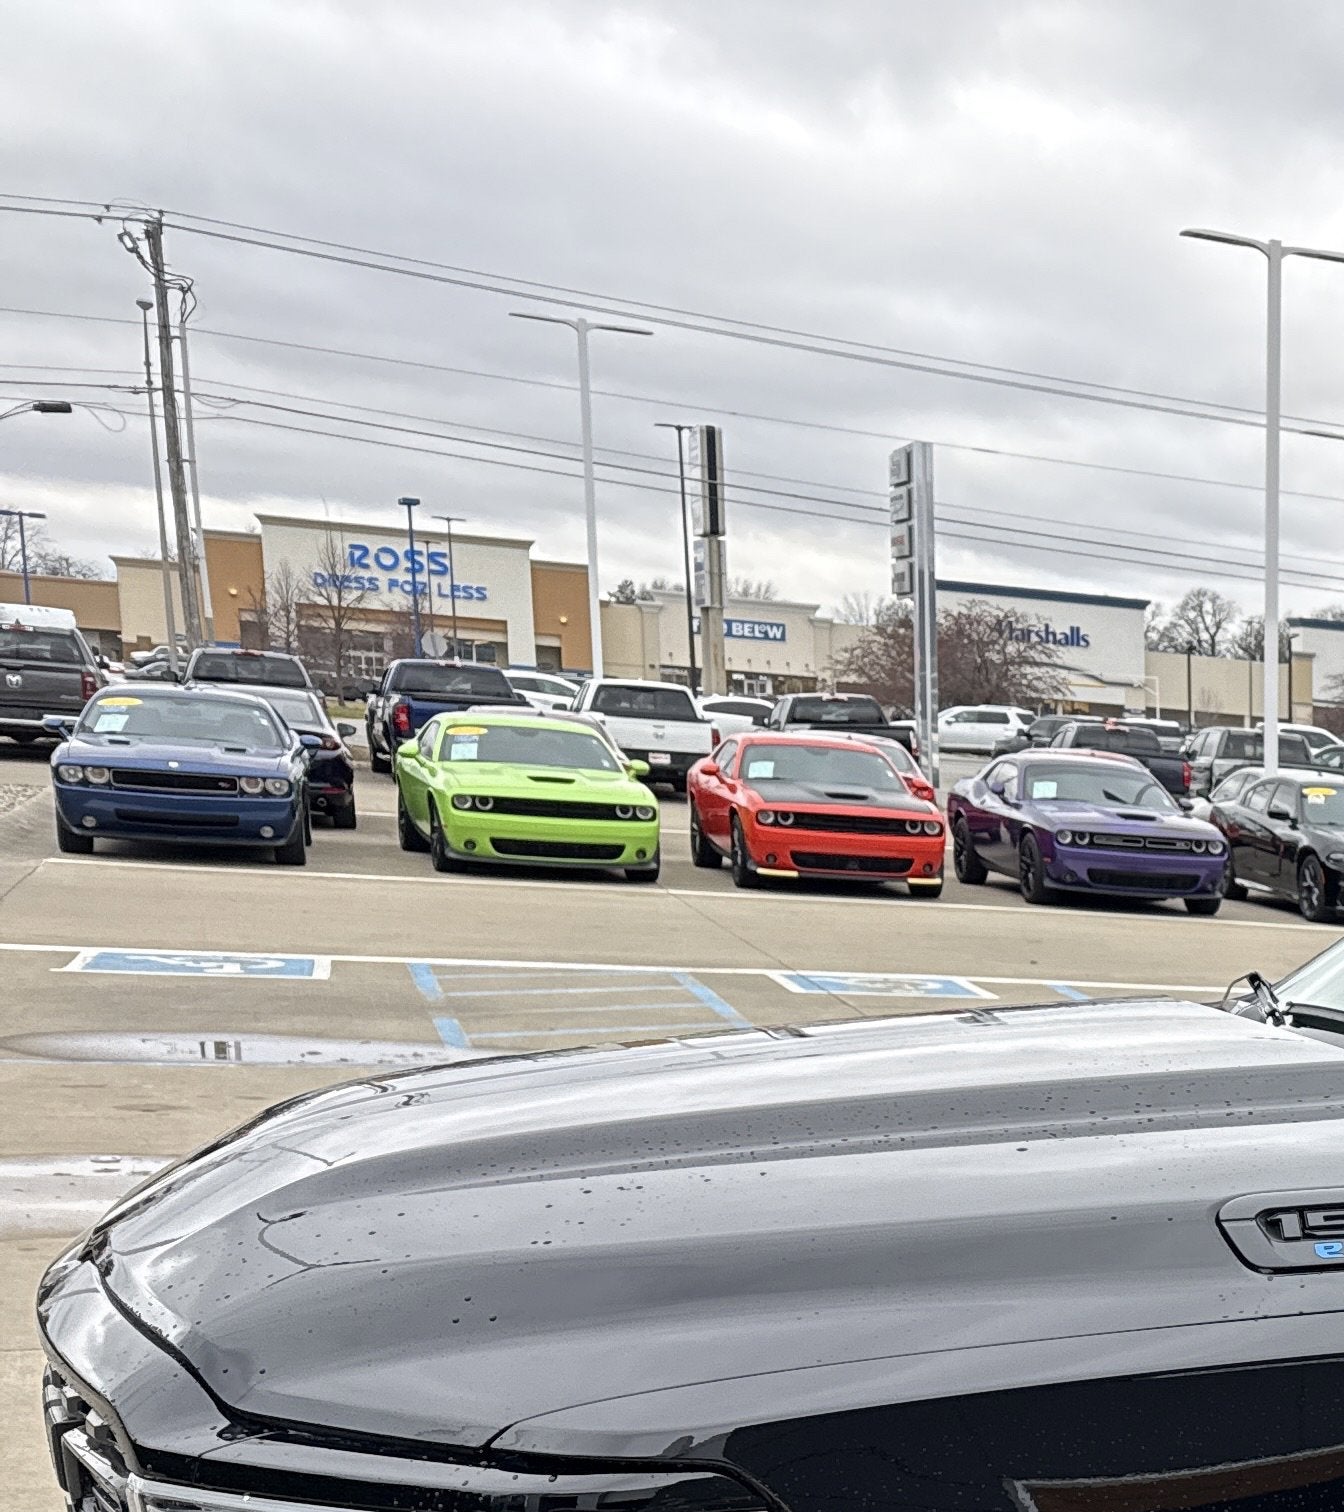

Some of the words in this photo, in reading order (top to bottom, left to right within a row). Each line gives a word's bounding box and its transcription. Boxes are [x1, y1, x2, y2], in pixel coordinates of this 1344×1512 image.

[347, 543, 449, 576] ROSS
[313, 571, 379, 592] DRESS
[437, 582, 488, 601] LESS
